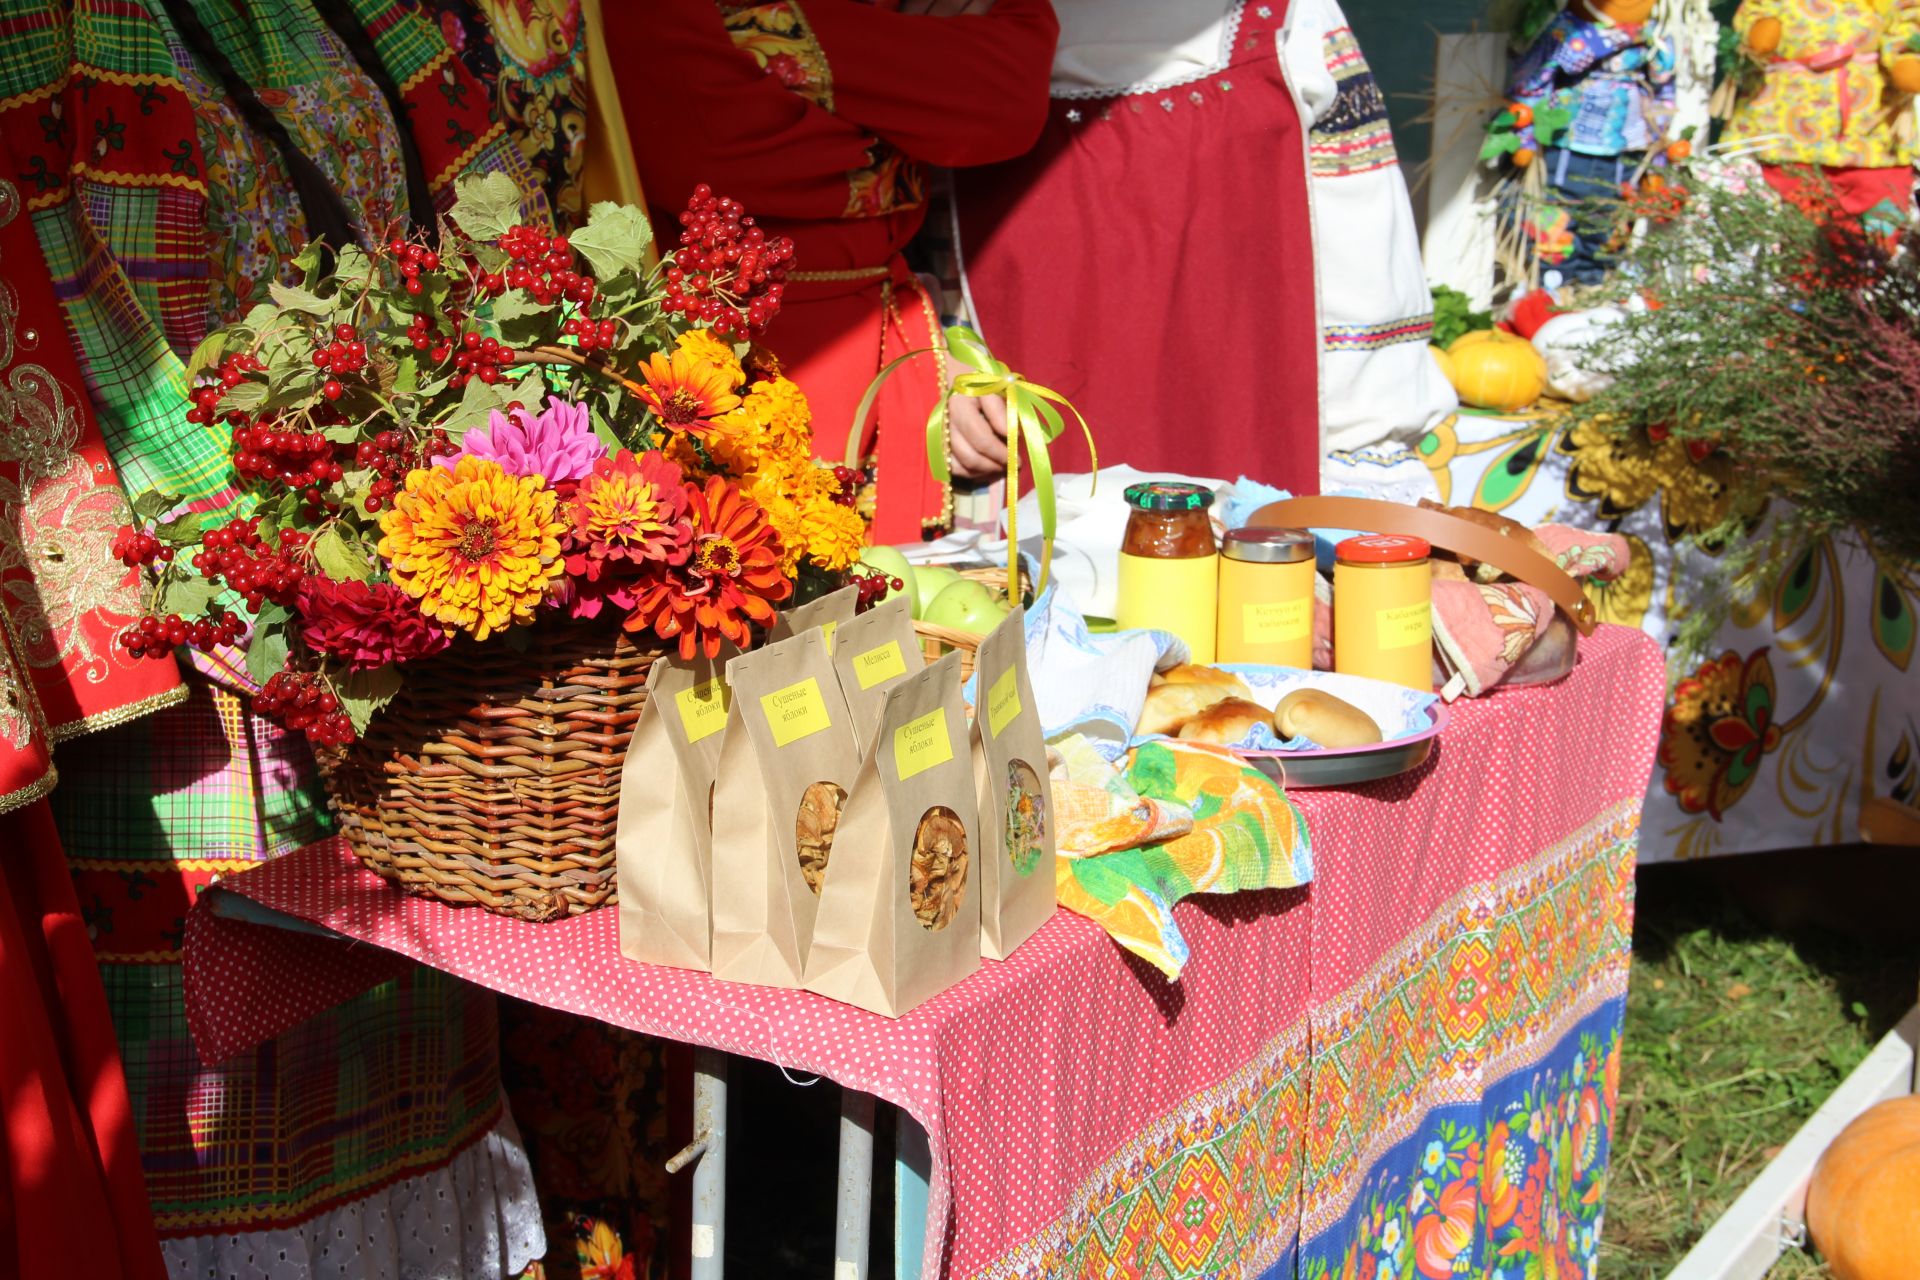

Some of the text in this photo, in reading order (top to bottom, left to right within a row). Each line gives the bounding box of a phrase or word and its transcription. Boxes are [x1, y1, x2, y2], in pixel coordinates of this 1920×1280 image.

[863, 650, 891, 666] Мелисса
[686, 682, 721, 704] Сушеные
[772, 687, 807, 709] Сушеные
[695, 700, 721, 718] яблоки
[782, 705, 808, 723] яблоки
[903, 719, 935, 740] Сушеные
[909, 737, 934, 755] яблоки
